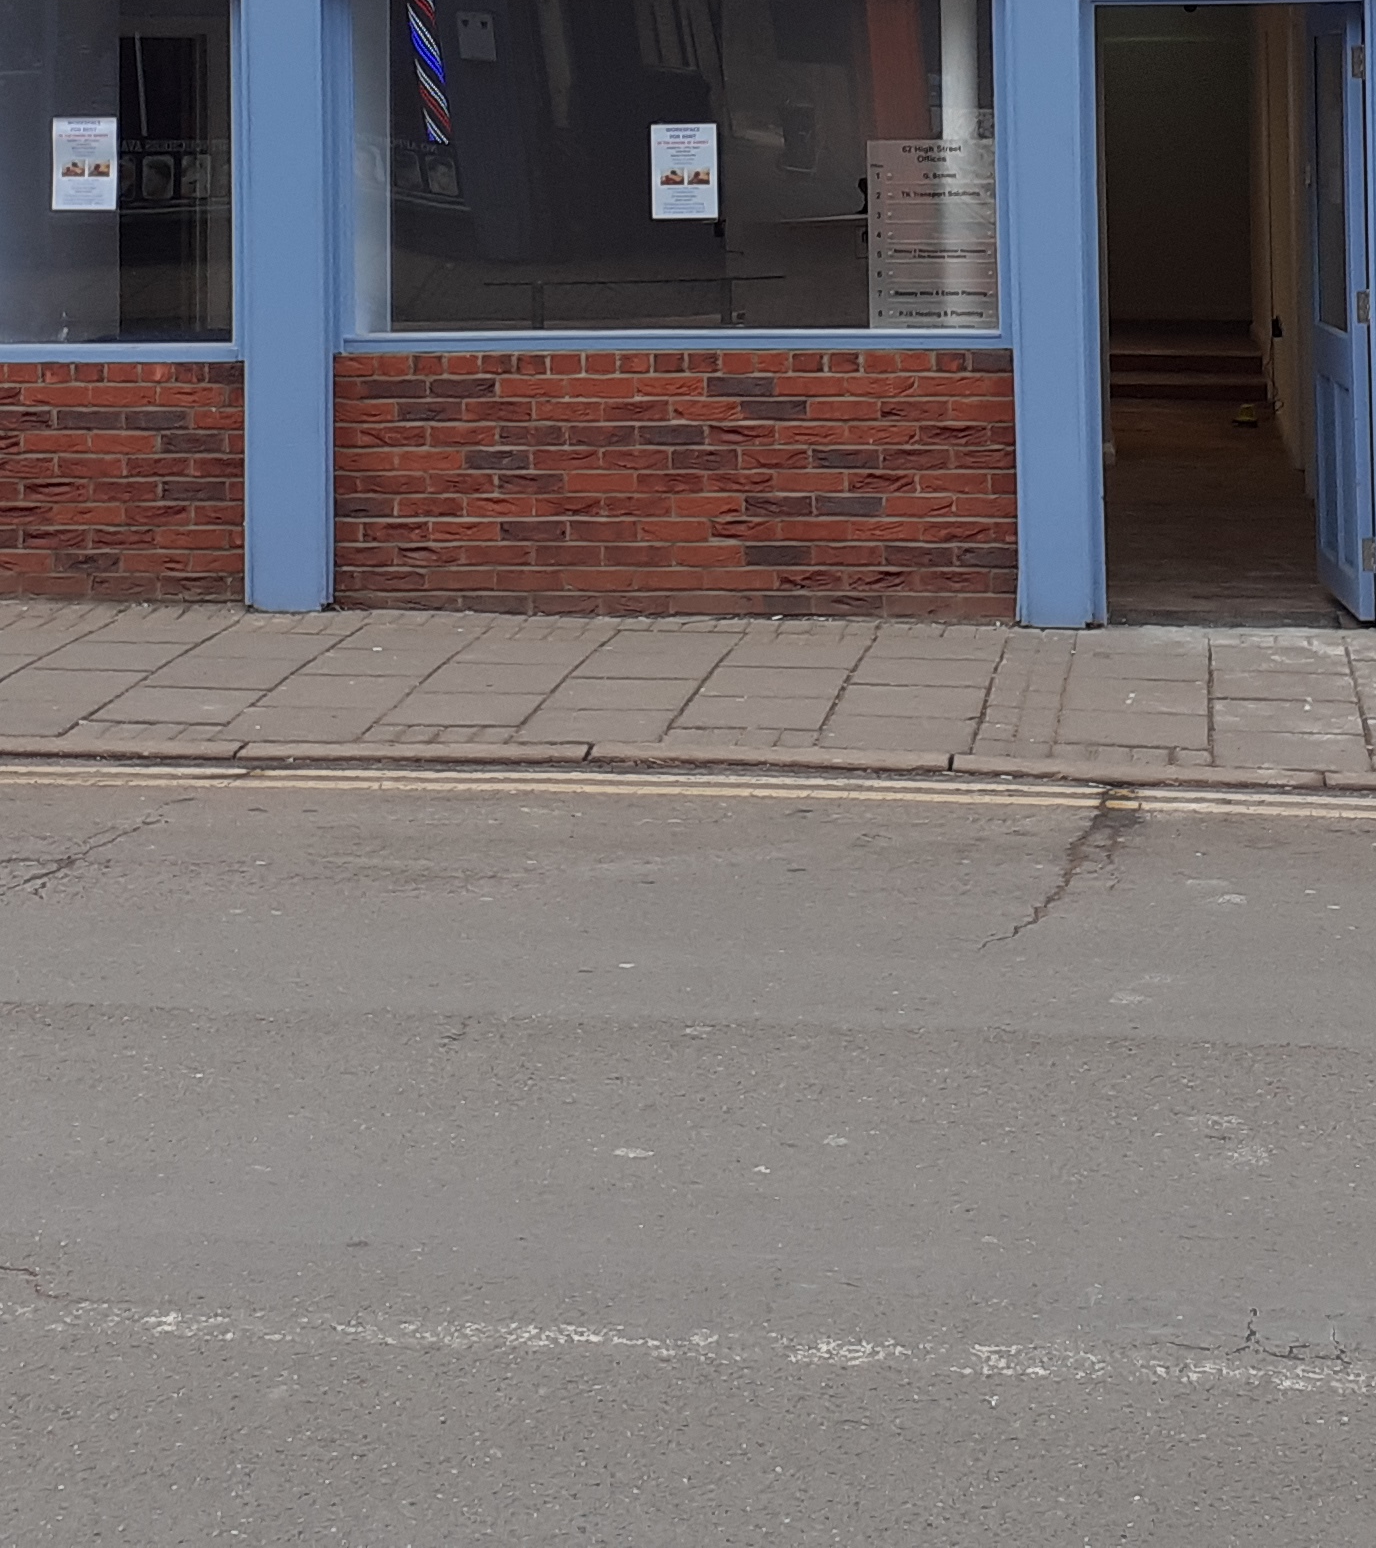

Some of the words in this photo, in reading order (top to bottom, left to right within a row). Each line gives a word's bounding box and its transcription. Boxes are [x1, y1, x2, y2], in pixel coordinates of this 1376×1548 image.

[914, 145, 934, 154] High
[936, 144, 962, 154] Street
[913, 191, 946, 199] Transport
[915, 310, 942, 319] Heating
